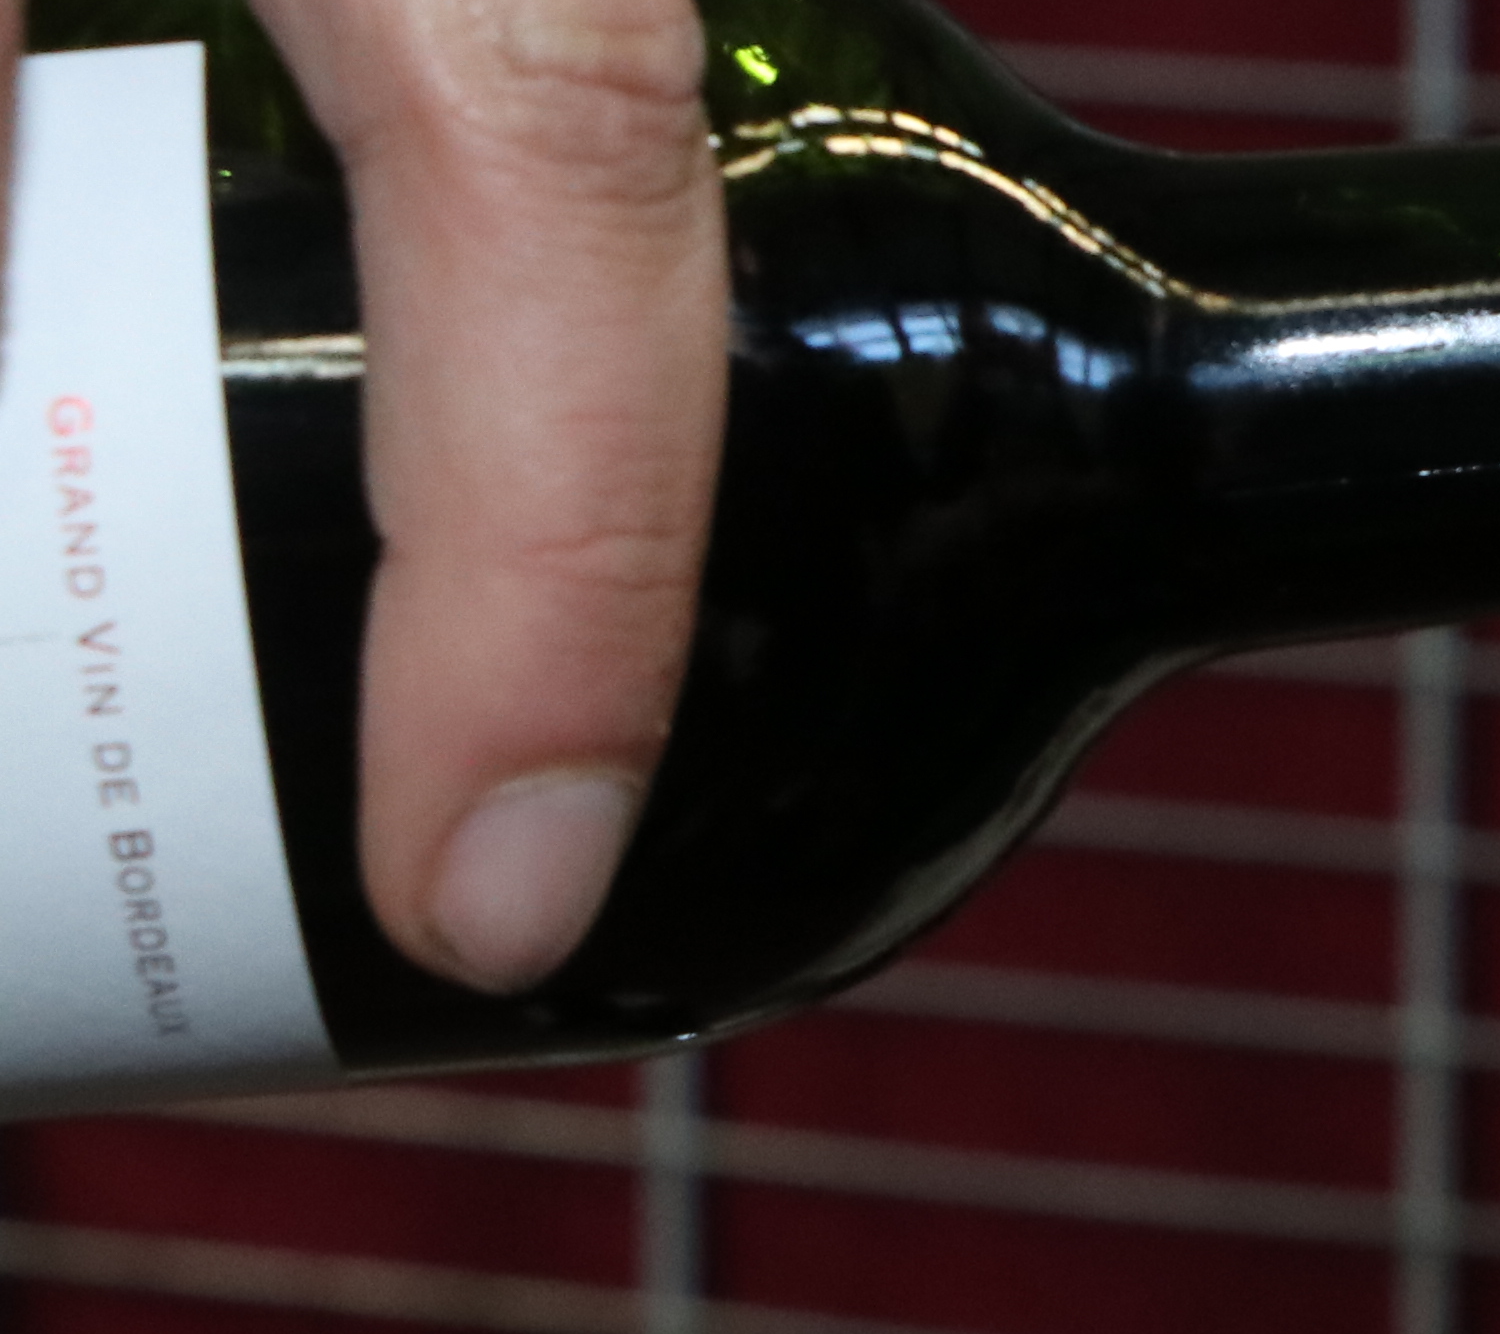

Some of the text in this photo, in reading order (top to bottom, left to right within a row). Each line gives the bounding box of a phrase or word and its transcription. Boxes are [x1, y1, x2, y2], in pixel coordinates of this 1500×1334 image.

[46, 394, 193, 1040] GRAND VIN DE BORDEAUX
